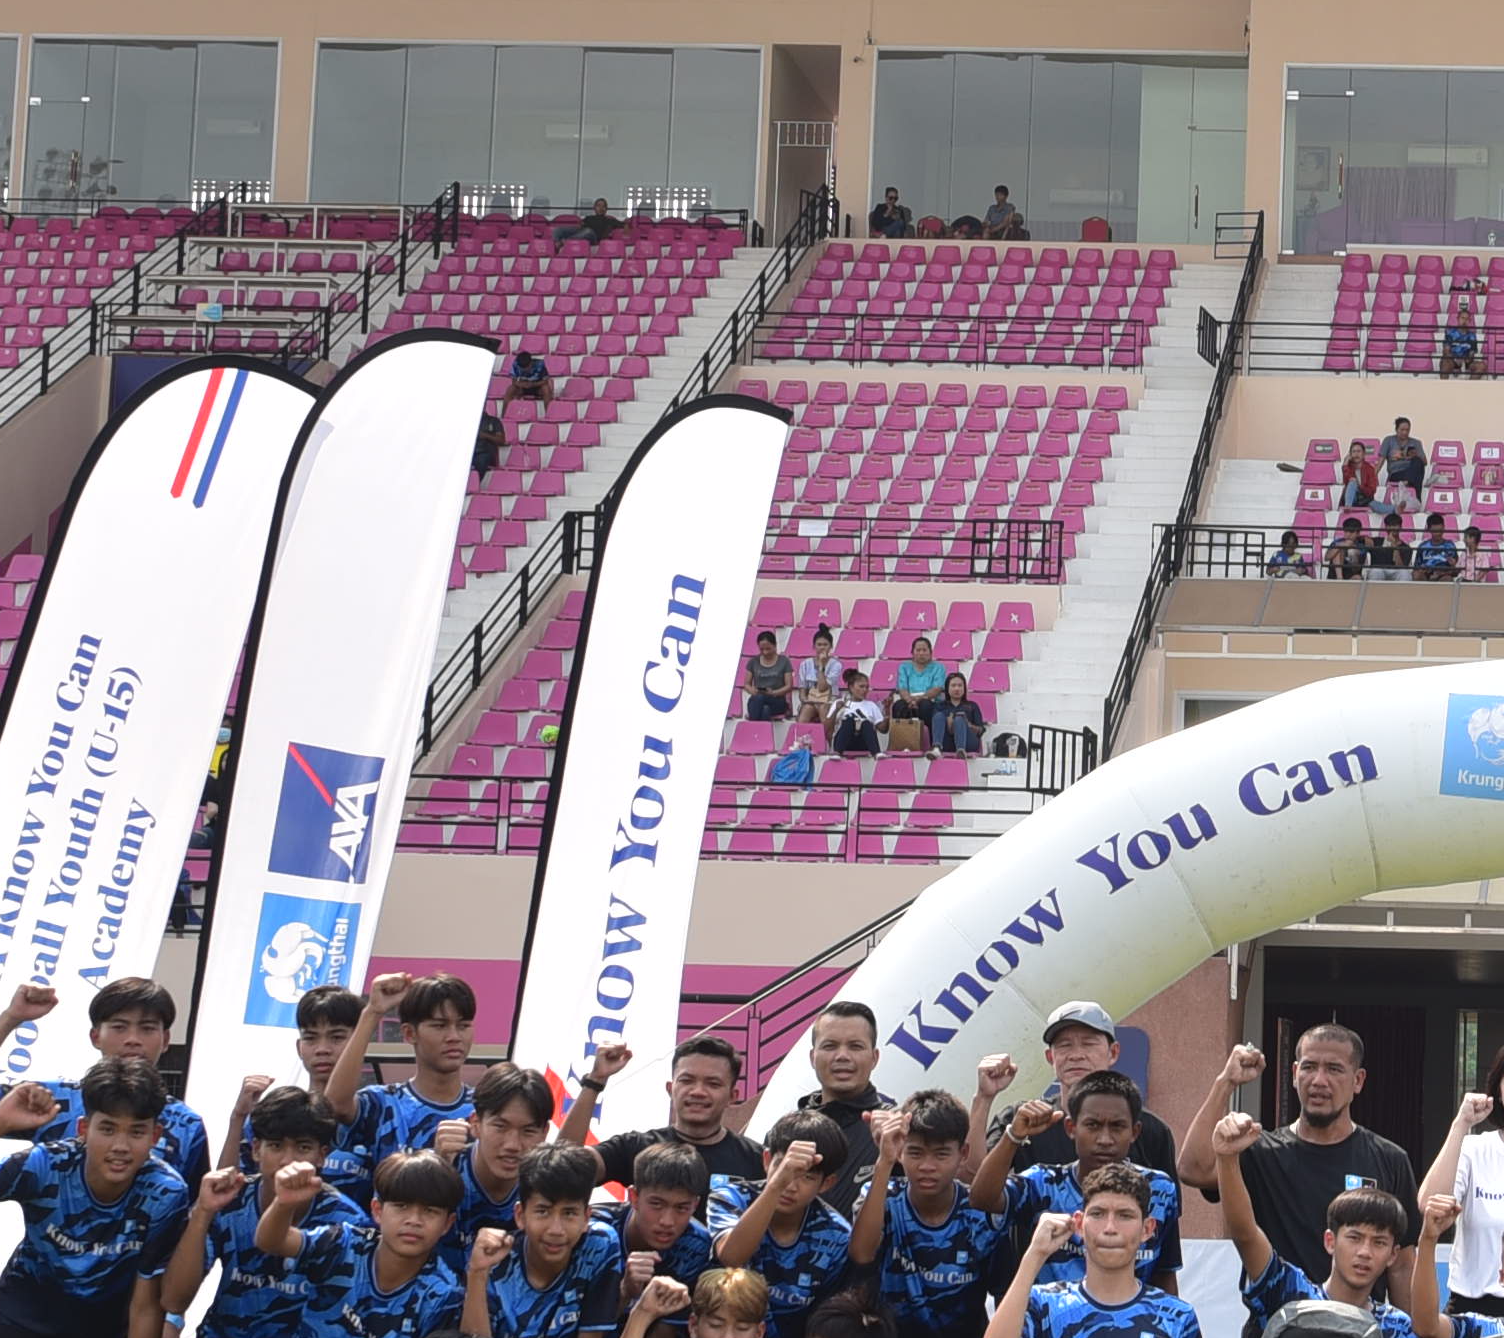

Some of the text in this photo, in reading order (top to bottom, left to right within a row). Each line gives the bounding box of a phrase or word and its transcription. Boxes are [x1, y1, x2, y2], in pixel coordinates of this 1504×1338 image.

[26, 723, 75, 799] You
[55, 630, 103, 713] Can
[610, 734, 674, 872] You
[643, 573, 707, 714] Can
[46, 784, 104, 908] Youth
[84, 666, 144, 777] (U-15)
[328, 781, 381, 883] AXA
[77, 797, 157, 990] Academy
[326, 916, 351, 986] ungthai
[885, 744, 1382, 1072] Know You Can
[323, 1156, 339, 1170] ou
[949, 1270, 974, 1285] Can
[1135, 1248, 1154, 1261] an
